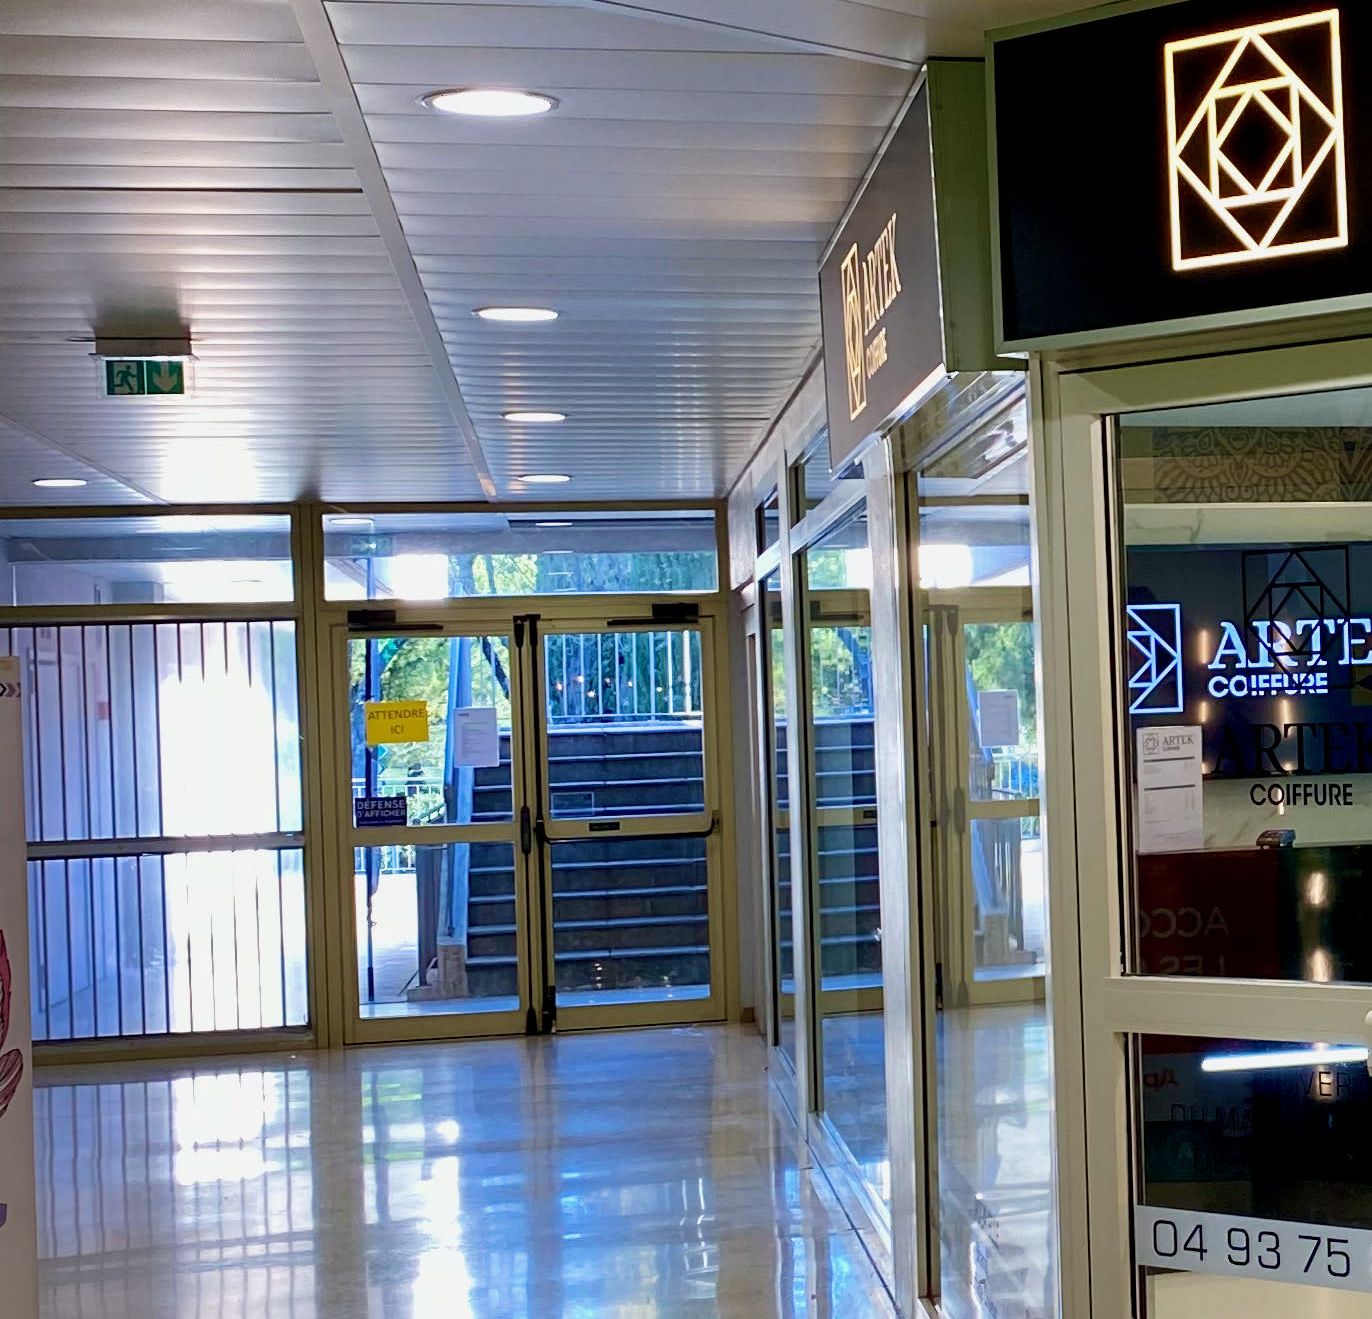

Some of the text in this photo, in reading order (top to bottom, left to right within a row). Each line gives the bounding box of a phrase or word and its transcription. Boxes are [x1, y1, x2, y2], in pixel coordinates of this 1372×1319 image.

[863, 213, 901, 336] ARTEK
[1208, 672, 1329, 697] COIFFURE
[368, 709, 425, 720] ATTENDRE
[390, 724, 404, 735] ICI
[1162, 734, 1195, 747] ARTEK
[357, 799, 405, 809] DÉFENSE
[1250, 783, 1353, 807] COIFFURE
[1153, 1219, 1208, 1261] 04
[1227, 1227, 1281, 1270] 93
[1298, 1235, 1351, 1278] 75
